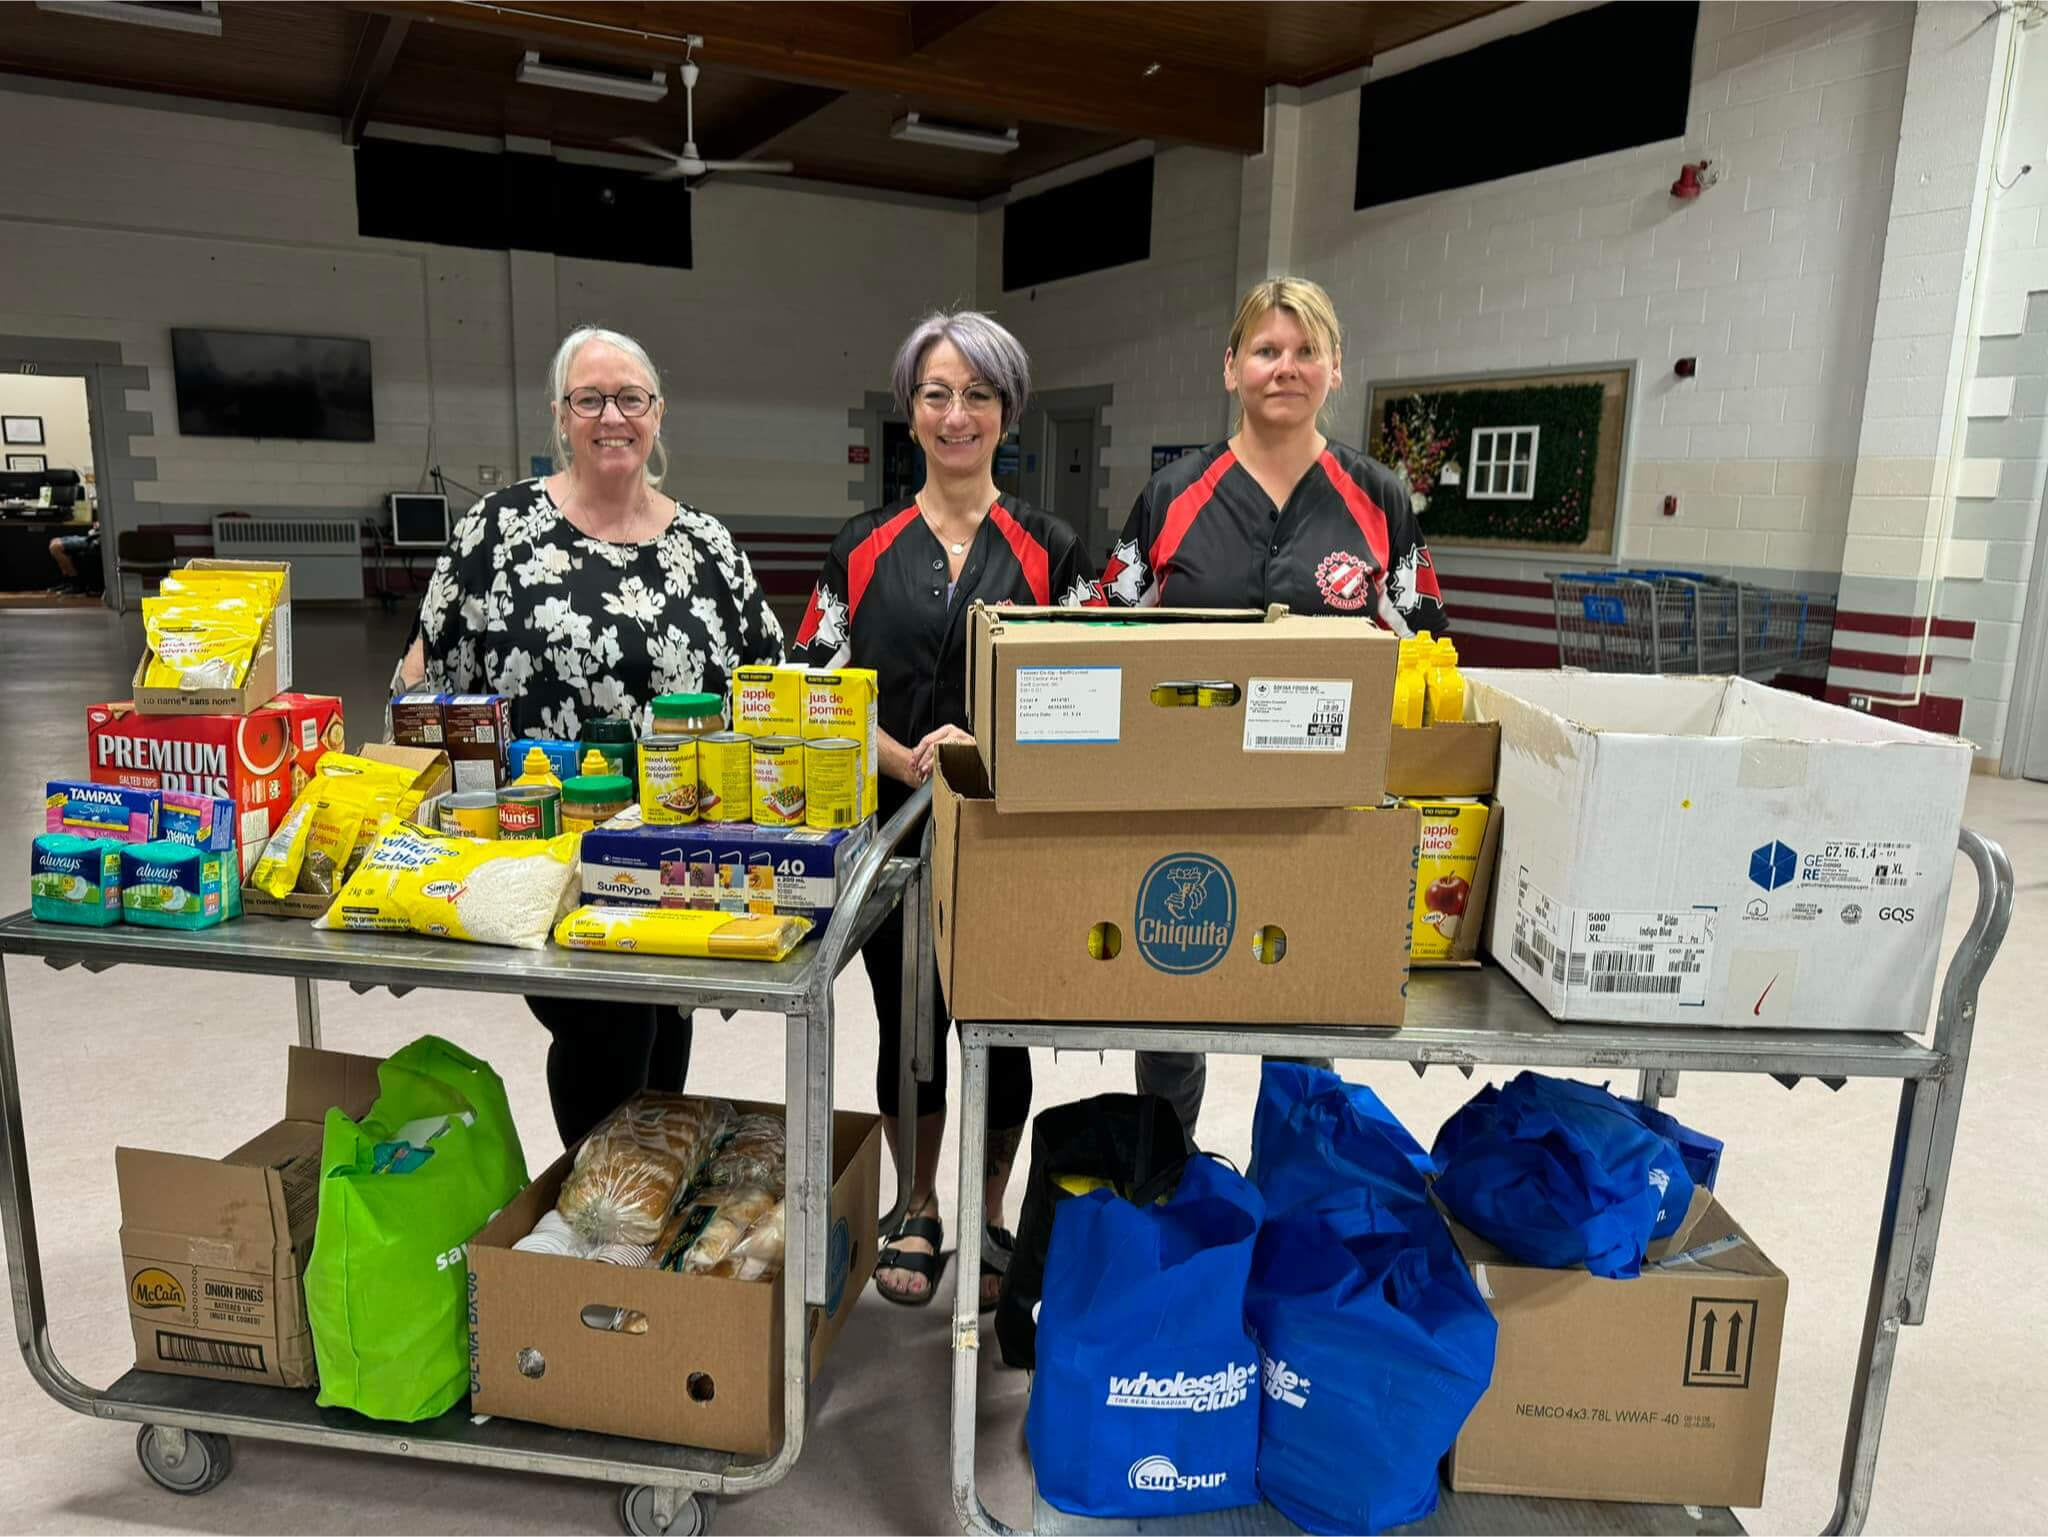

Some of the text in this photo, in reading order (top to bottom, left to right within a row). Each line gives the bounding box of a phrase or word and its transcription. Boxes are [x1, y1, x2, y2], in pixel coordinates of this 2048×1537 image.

[1331, 597, 1365, 609] CANADA
[742, 688, 775, 701] apple
[809, 691, 844, 705] jus de
[742, 700, 771, 714] juice
[809, 705, 854, 717] pomme
[1311, 712, 1344, 724] 01150
[97, 734, 229, 777] PREMIUM
[119, 775, 157, 787] SALTED TOPS
[70, 787, 122, 805] TAMPAX
[499, 807, 536, 825] Hunt's
[166, 828, 196, 848] TAMPAX
[1423, 824, 1459, 837] apple
[382, 836, 460, 857] white rice
[1421, 837, 1453, 851] juice
[38, 851, 82, 873] always
[776, 859, 805, 876] 40
[1892, 862, 1904, 875] XL
[135, 862, 180, 885] always
[38, 882, 46, 896] 2
[597, 880, 651, 897] SunRype
[133, 894, 142, 909] 2
[1588, 912, 1611, 922] 5000
[1878, 906, 1915, 925] GQS
[1589, 923, 1606, 932] 080
[1639, 926, 1672, 938] Indigo Blue
[1139, 918, 1229, 953] Chiquita
[1588, 933, 1601, 943] XL
[136, 1282, 181, 1302] McCain
[204, 1283, 264, 1303] ONION RINGS
[213, 1301, 241, 1313] BATTERED
[209, 1310, 262, 1325] (MUST BE COOKED)
[1109, 1361, 1248, 1398] wholesale
[1192, 1387, 1240, 1413] club
[1515, 1403, 1565, 1419] NEMCO
[1565, 1407, 1612, 1423] 4x3.78L
[1614, 1409, 1659, 1425] WWAF
